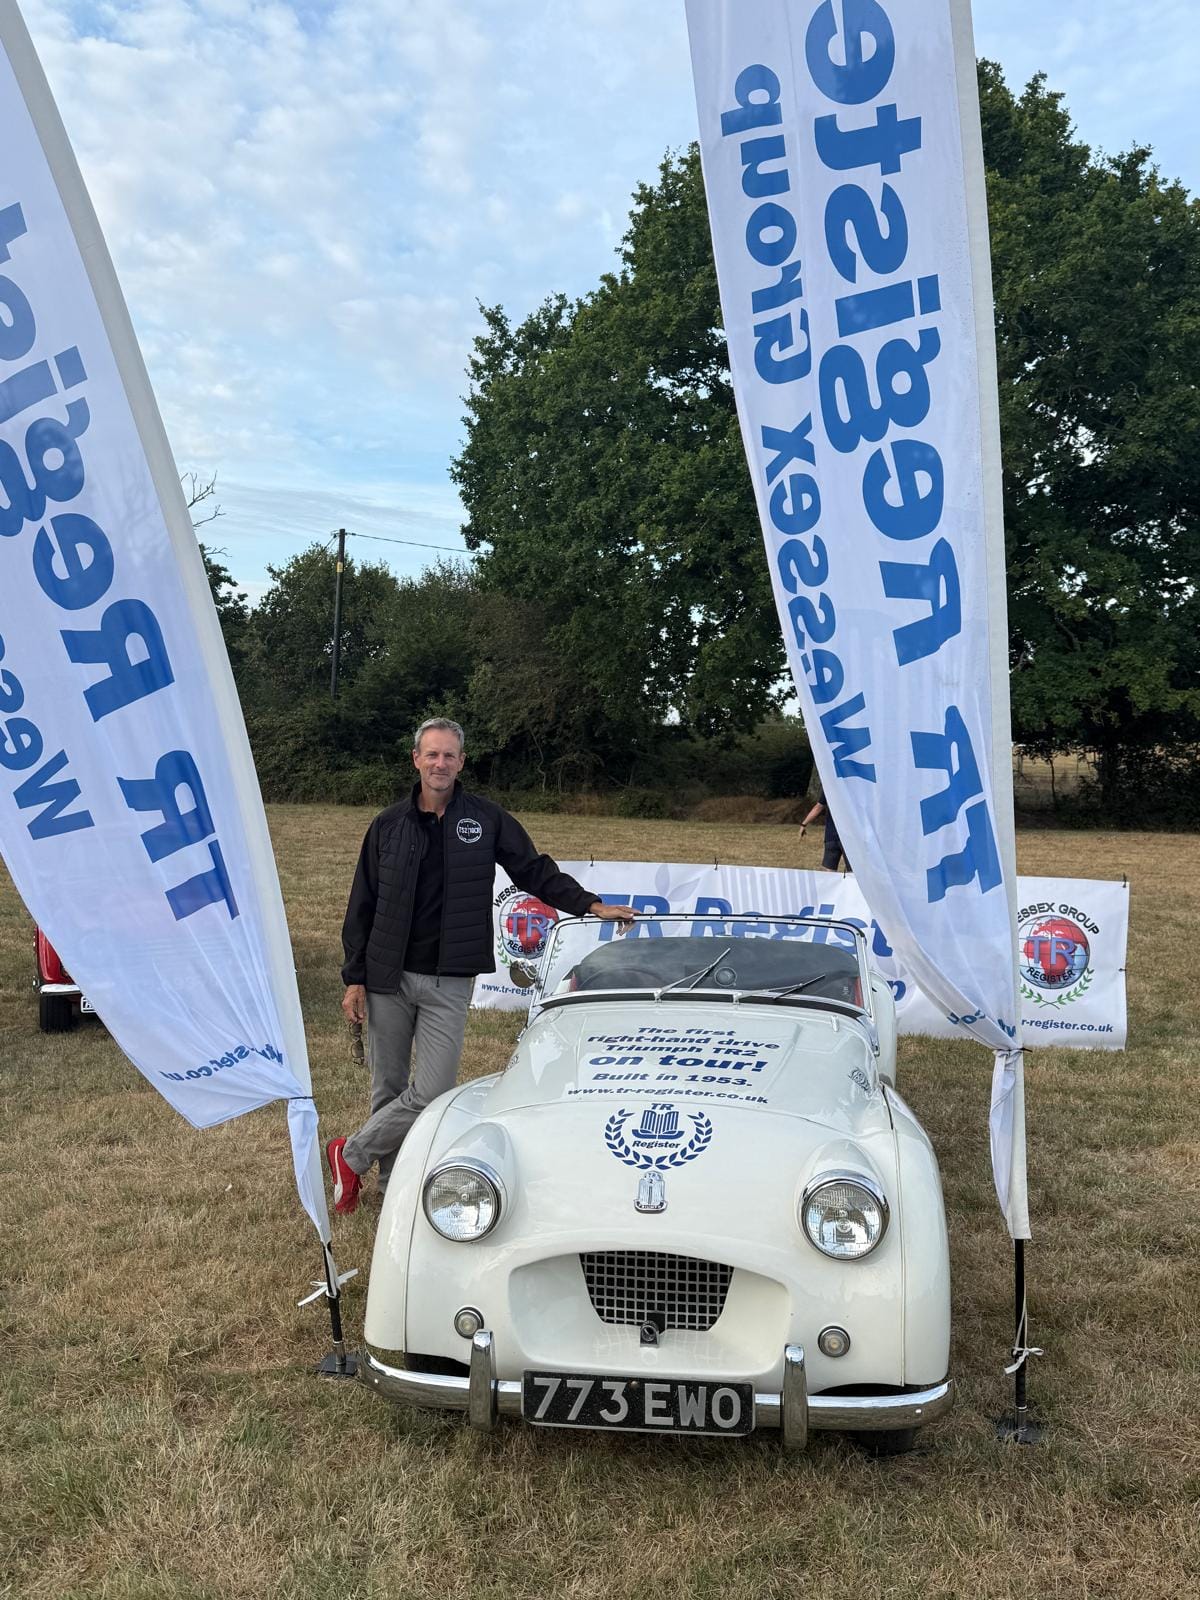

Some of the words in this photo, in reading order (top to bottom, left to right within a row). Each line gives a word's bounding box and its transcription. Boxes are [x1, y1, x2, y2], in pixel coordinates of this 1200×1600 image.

[510, 912, 549, 940] TR
[599, 894, 670, 942] TR
[1059, 904, 1100, 935] GROUP
[506, 939, 547, 954] REGISTER
[1026, 936, 1075, 966] TR
[1027, 966, 1075, 983] REGISTER
[638, 1027, 679, 1035] The
[685, 1028, 737, 1036] first
[587, 1035, 711, 1045] right-hand
[717, 1038, 781, 1050] drive
[605, 1044, 703, 1054] Triumph
[712, 1047, 760, 1057] TR2
[588, 1055, 644, 1066] on
[658, 1055, 769, 1073] tour!
[592, 1073, 650, 1082] Built
[655, 1073, 679, 1081] in
[687, 1074, 753, 1086] 1953.
[567, 1087, 769, 1104] www.tr-register.co.uk
[651, 1102, 675, 1111] TR
[632, 1140, 681, 1149] Register
[533, 1377, 629, 1423] 773
[644, 1382, 742, 1429] EWO
